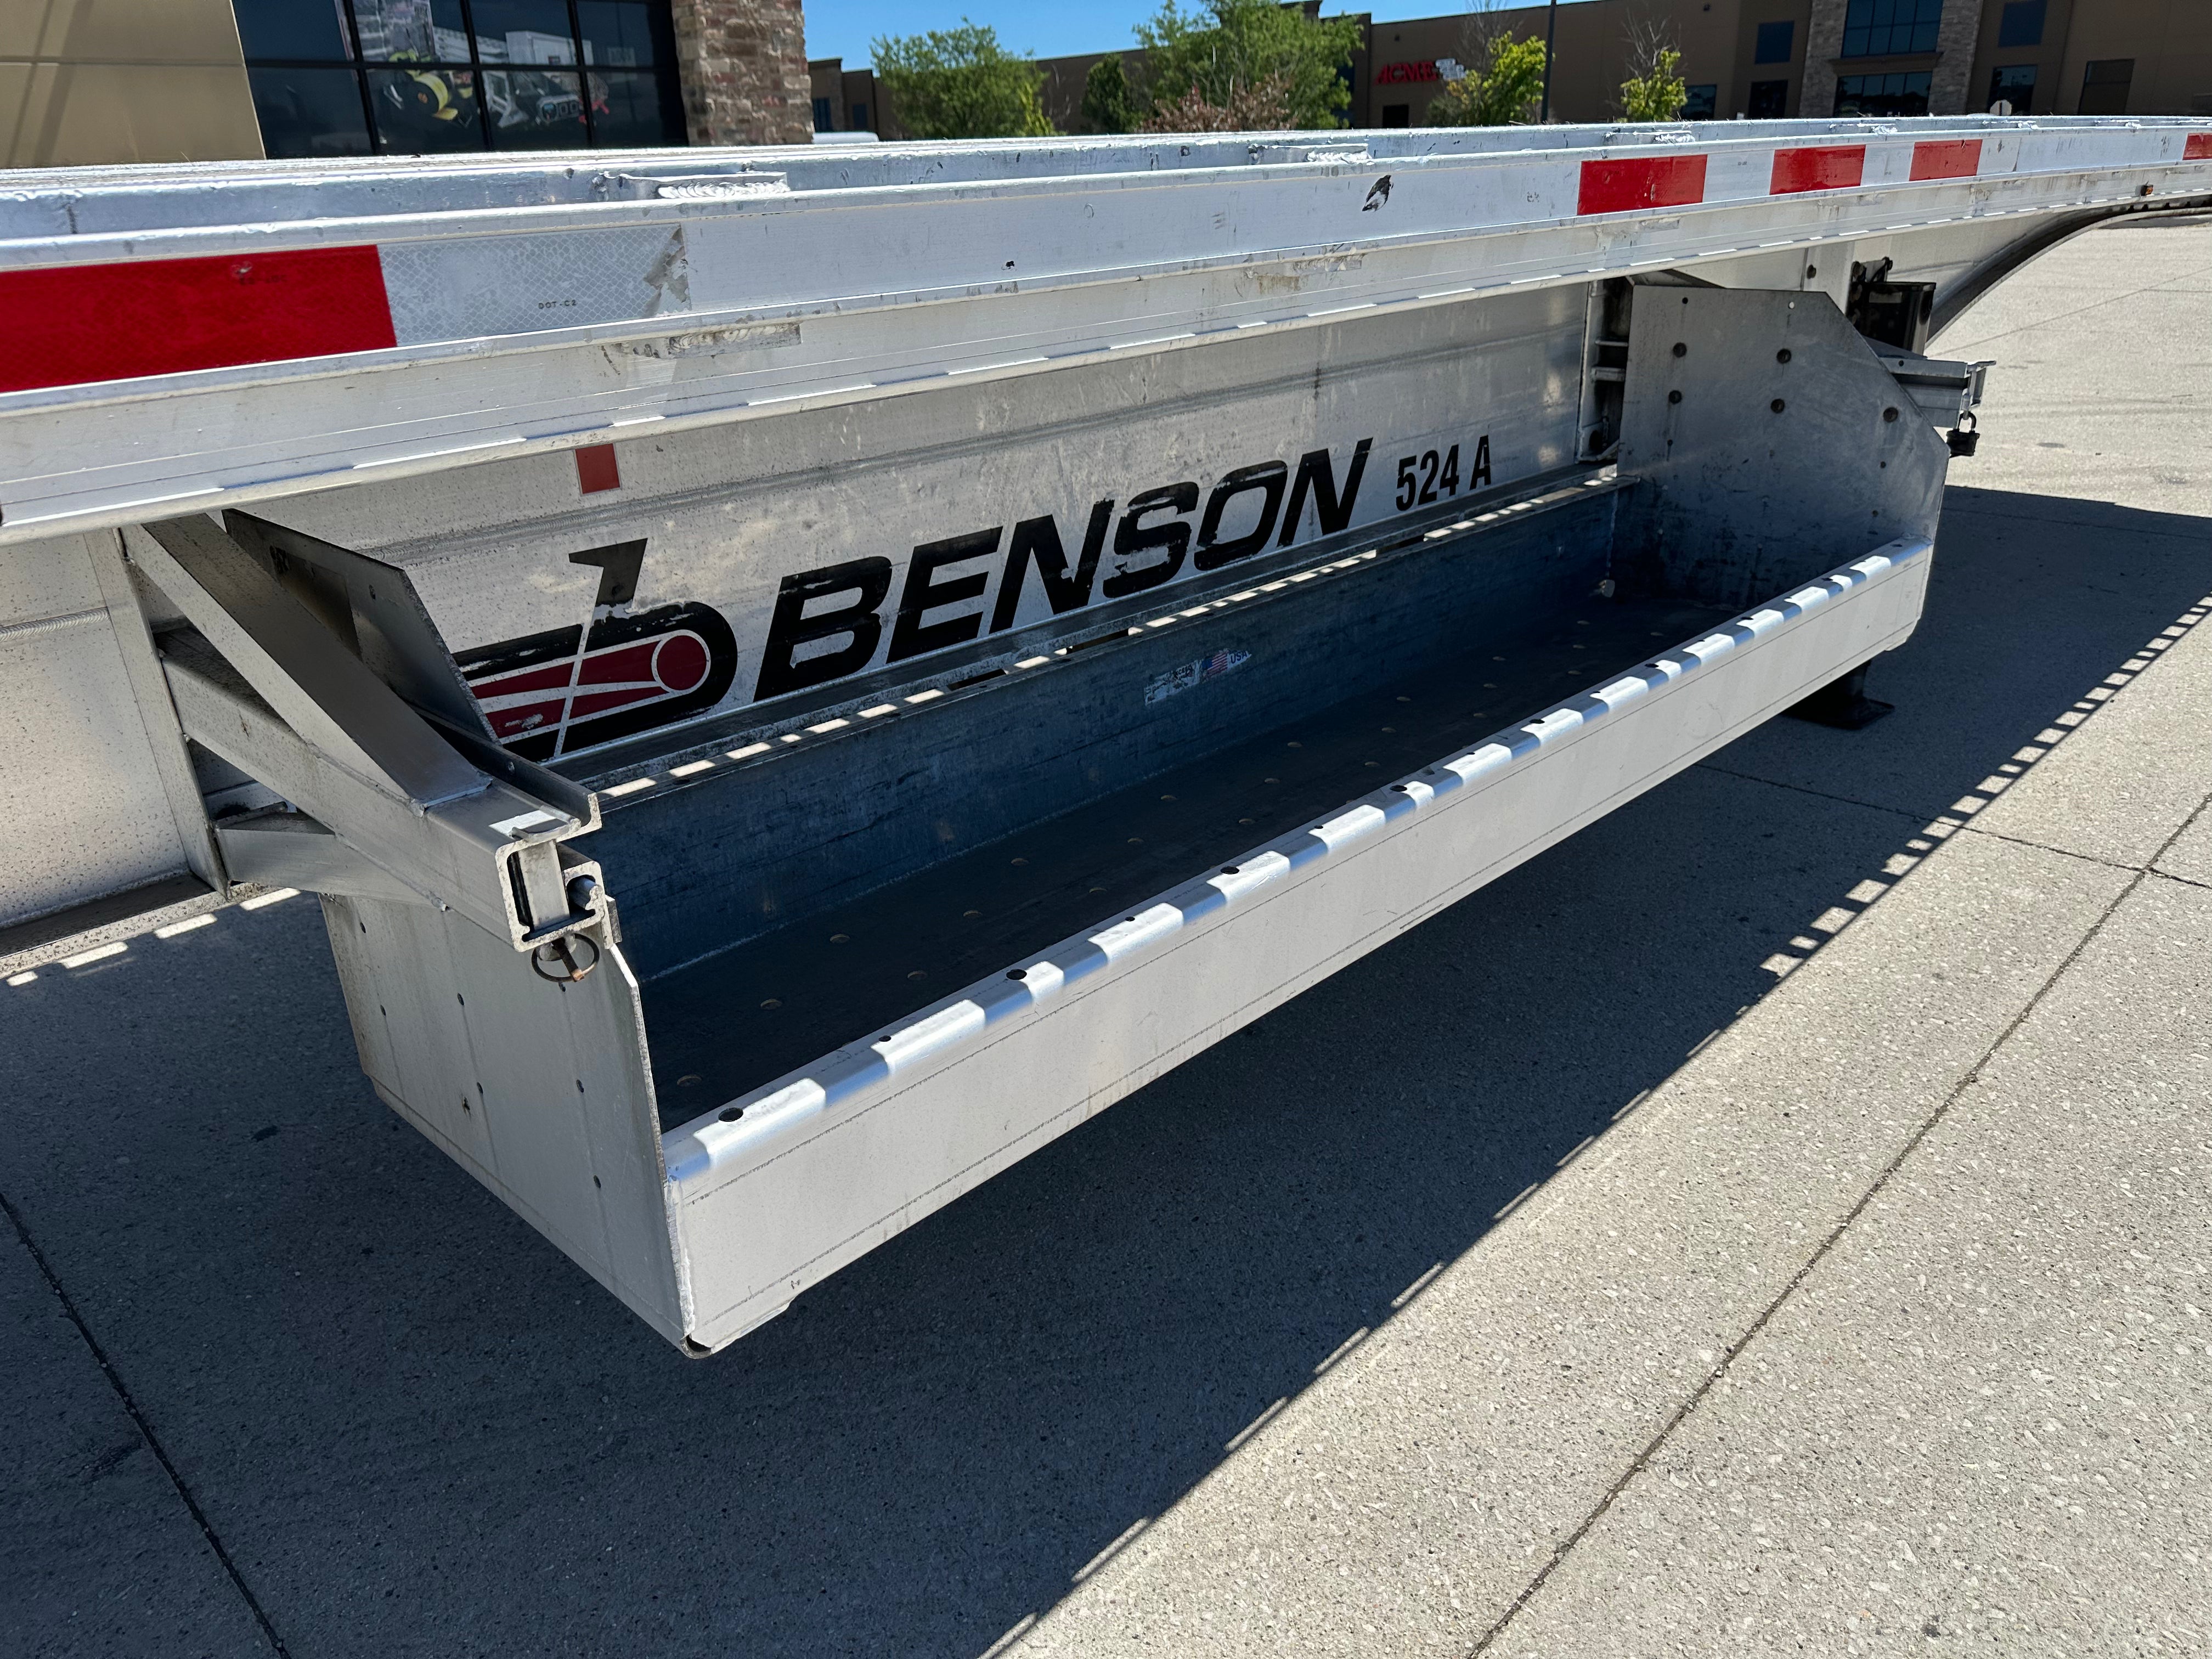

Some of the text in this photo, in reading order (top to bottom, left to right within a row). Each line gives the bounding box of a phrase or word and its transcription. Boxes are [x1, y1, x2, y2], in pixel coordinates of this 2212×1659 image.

[1375, 61, 1438, 84] ACME
[538, 299, 577, 309] DOT-C2
[1396, 435, 1491, 511] 524 A
[754, 437, 1374, 703] BENSON
[1231, 651, 1248, 664] USA
